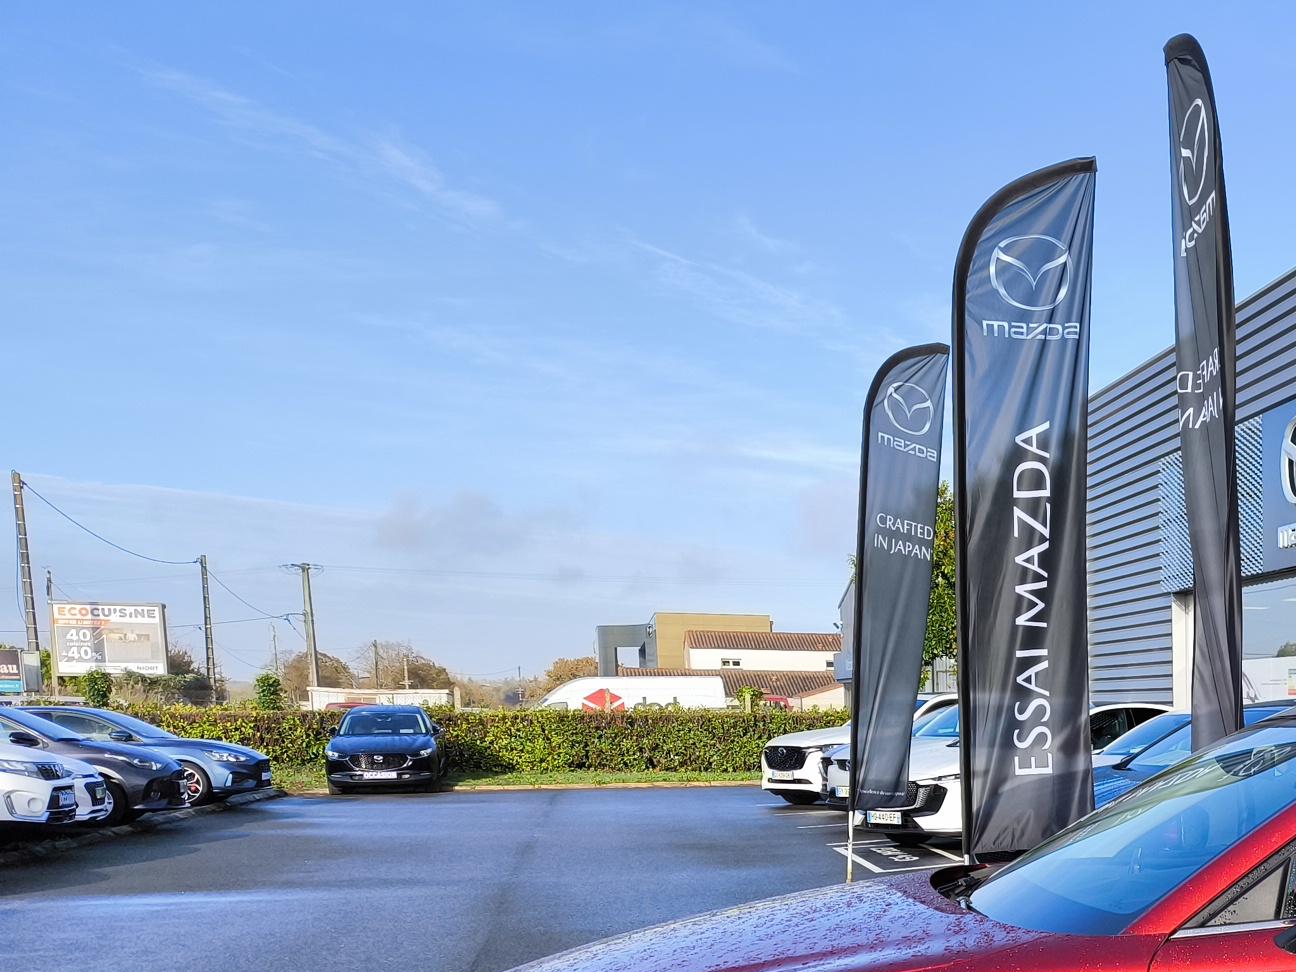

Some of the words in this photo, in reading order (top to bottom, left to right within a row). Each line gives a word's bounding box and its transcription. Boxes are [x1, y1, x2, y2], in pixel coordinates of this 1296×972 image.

[982, 319, 1080, 340] mazda
[877, 431, 937, 463] mazda
[876, 512, 934, 541] CRAFTED
[1012, 420, 1052, 628] MAZDA
[874, 533, 888, 551] IN
[890, 539, 932, 562] JAPAN
[66, 629, 91, 641] 40
[1014, 648, 1054, 776] ESSAI
